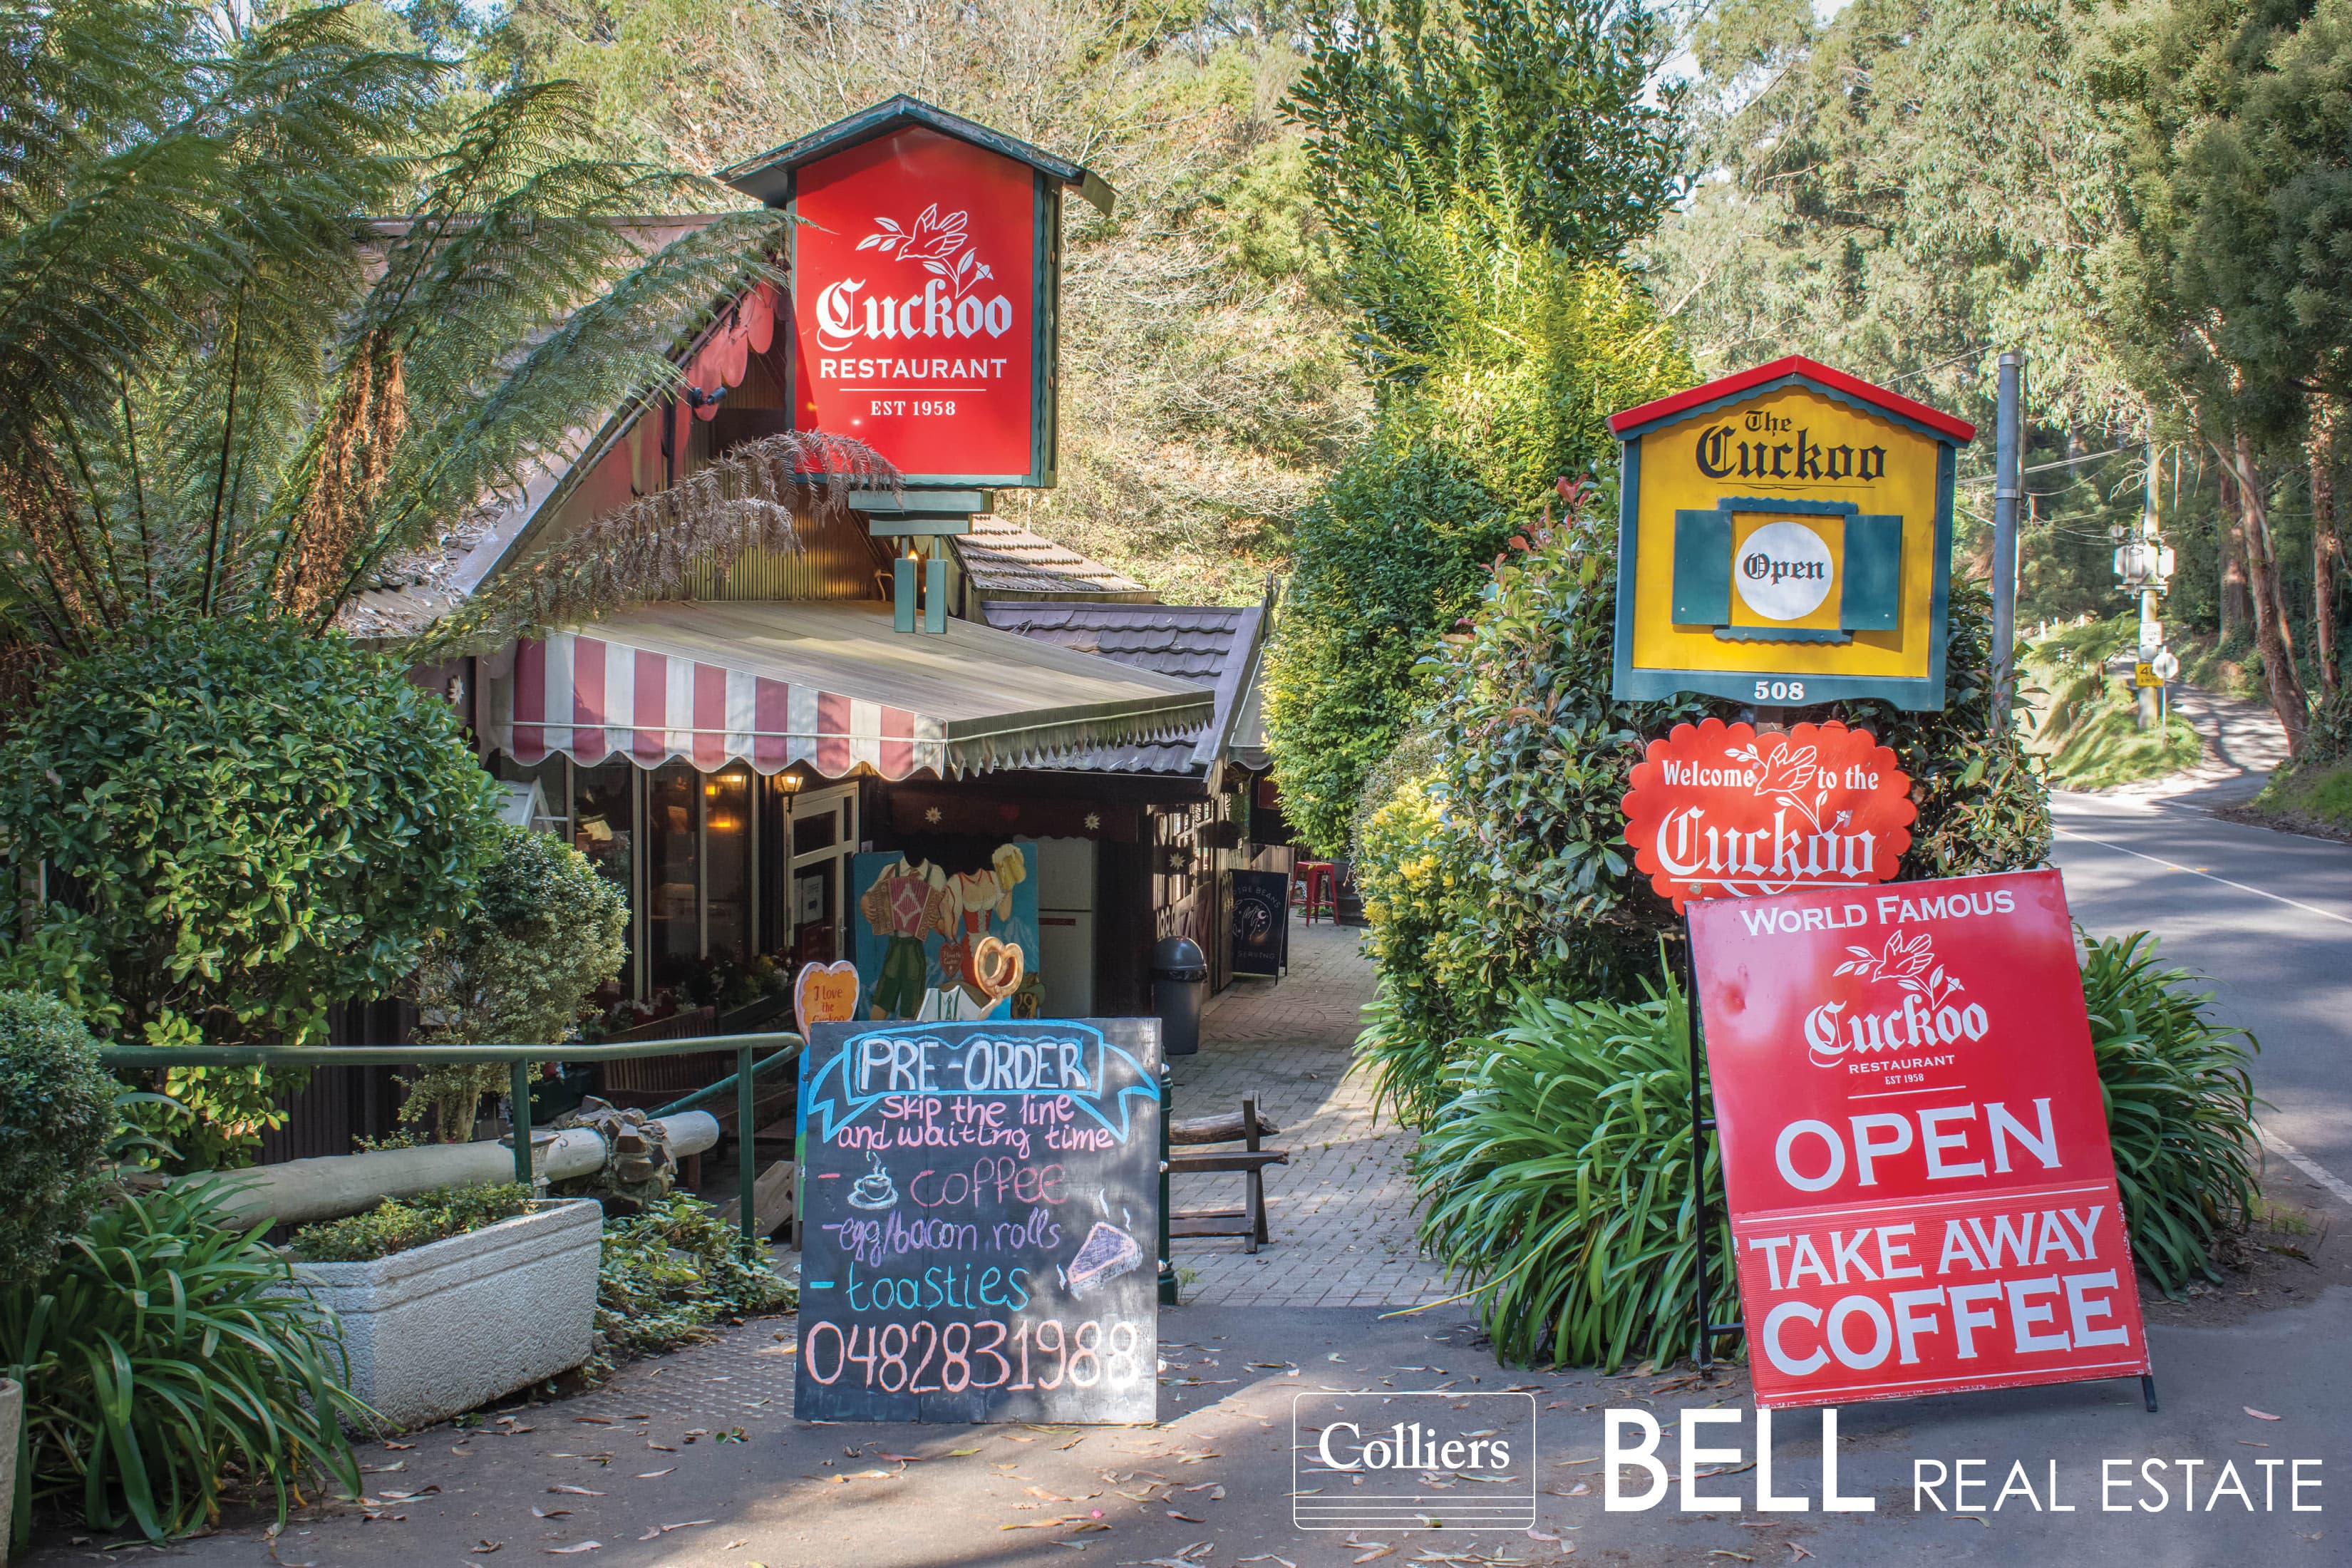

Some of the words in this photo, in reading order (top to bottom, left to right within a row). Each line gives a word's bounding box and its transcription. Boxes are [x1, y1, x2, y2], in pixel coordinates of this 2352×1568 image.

[816, 277, 1012, 351] Cuckoo
[820, 359, 1007, 378] RESTAURANT
[871, 401, 905, 416] EST
[912, 401, 956, 416] 1958
[1745, 410, 1792, 437] The
[1696, 425, 1887, 482] Cuckoo
[1743, 552, 1825, 586] Open
[1753, 681, 1805, 701] 508
[1662, 759, 1755, 787] Welcome
[1817, 766, 1837, 790] to
[1845, 764, 1879, 790] the
[1656, 805, 1876, 878] Cuckoo
[1740, 904, 1868, 937] WORLD
[1875, 889, 2016, 925] FAMOUS
[822, 986, 842, 1000] love
[822, 1001, 834, 1013] the
[1804, 994, 1989, 1068] Cuckoo
[1849, 1055, 1955, 1073] RESTAURANT
[1884, 1075, 1902, 1085] EST
[1904, 1073, 1924, 1083] 1958
[950, 1095, 1006, 1128] the
[1019, 1094, 1076, 1125] line
[837, 1120, 892, 1150] and
[897, 1122, 1031, 1159] waiting
[1044, 1124, 1114, 1150] time
[1775, 1098, 2063, 1192] OPEN
[994, 1206, 1062, 1251] rolls
[1749, 1222, 1923, 1291] TAKE
[1937, 1205, 2105, 1274] AWAY
[845, 1261, 1031, 1312] toasties
[1763, 1269, 2130, 1376] COFFEE
[805, 1319, 1139, 1393] 0482831988
